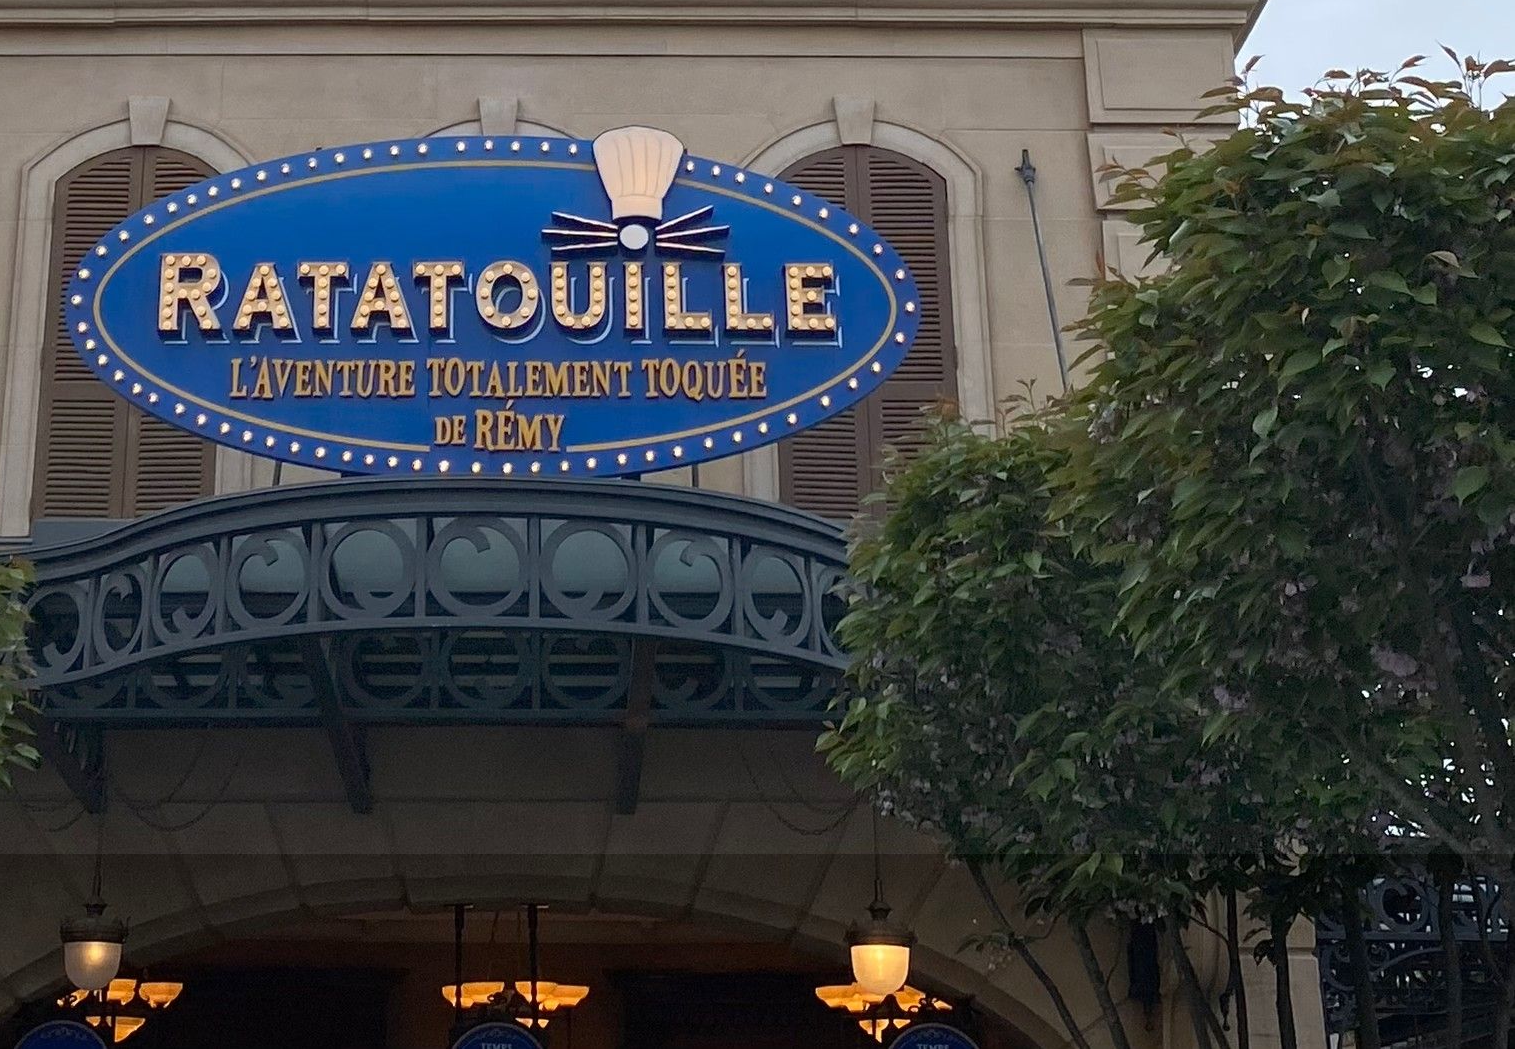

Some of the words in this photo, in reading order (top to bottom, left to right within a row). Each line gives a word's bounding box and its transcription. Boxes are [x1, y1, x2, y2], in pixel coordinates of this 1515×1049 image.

[157, 252, 836, 334] RATATOUILLE
[229, 356, 416, 399] L'AVENTURE
[426, 356, 633, 399] TOTALEMENT
[641, 349, 768, 401] TOQUÉE
[434, 415, 467, 446] DE
[474, 400, 566, 452] RÉMY
